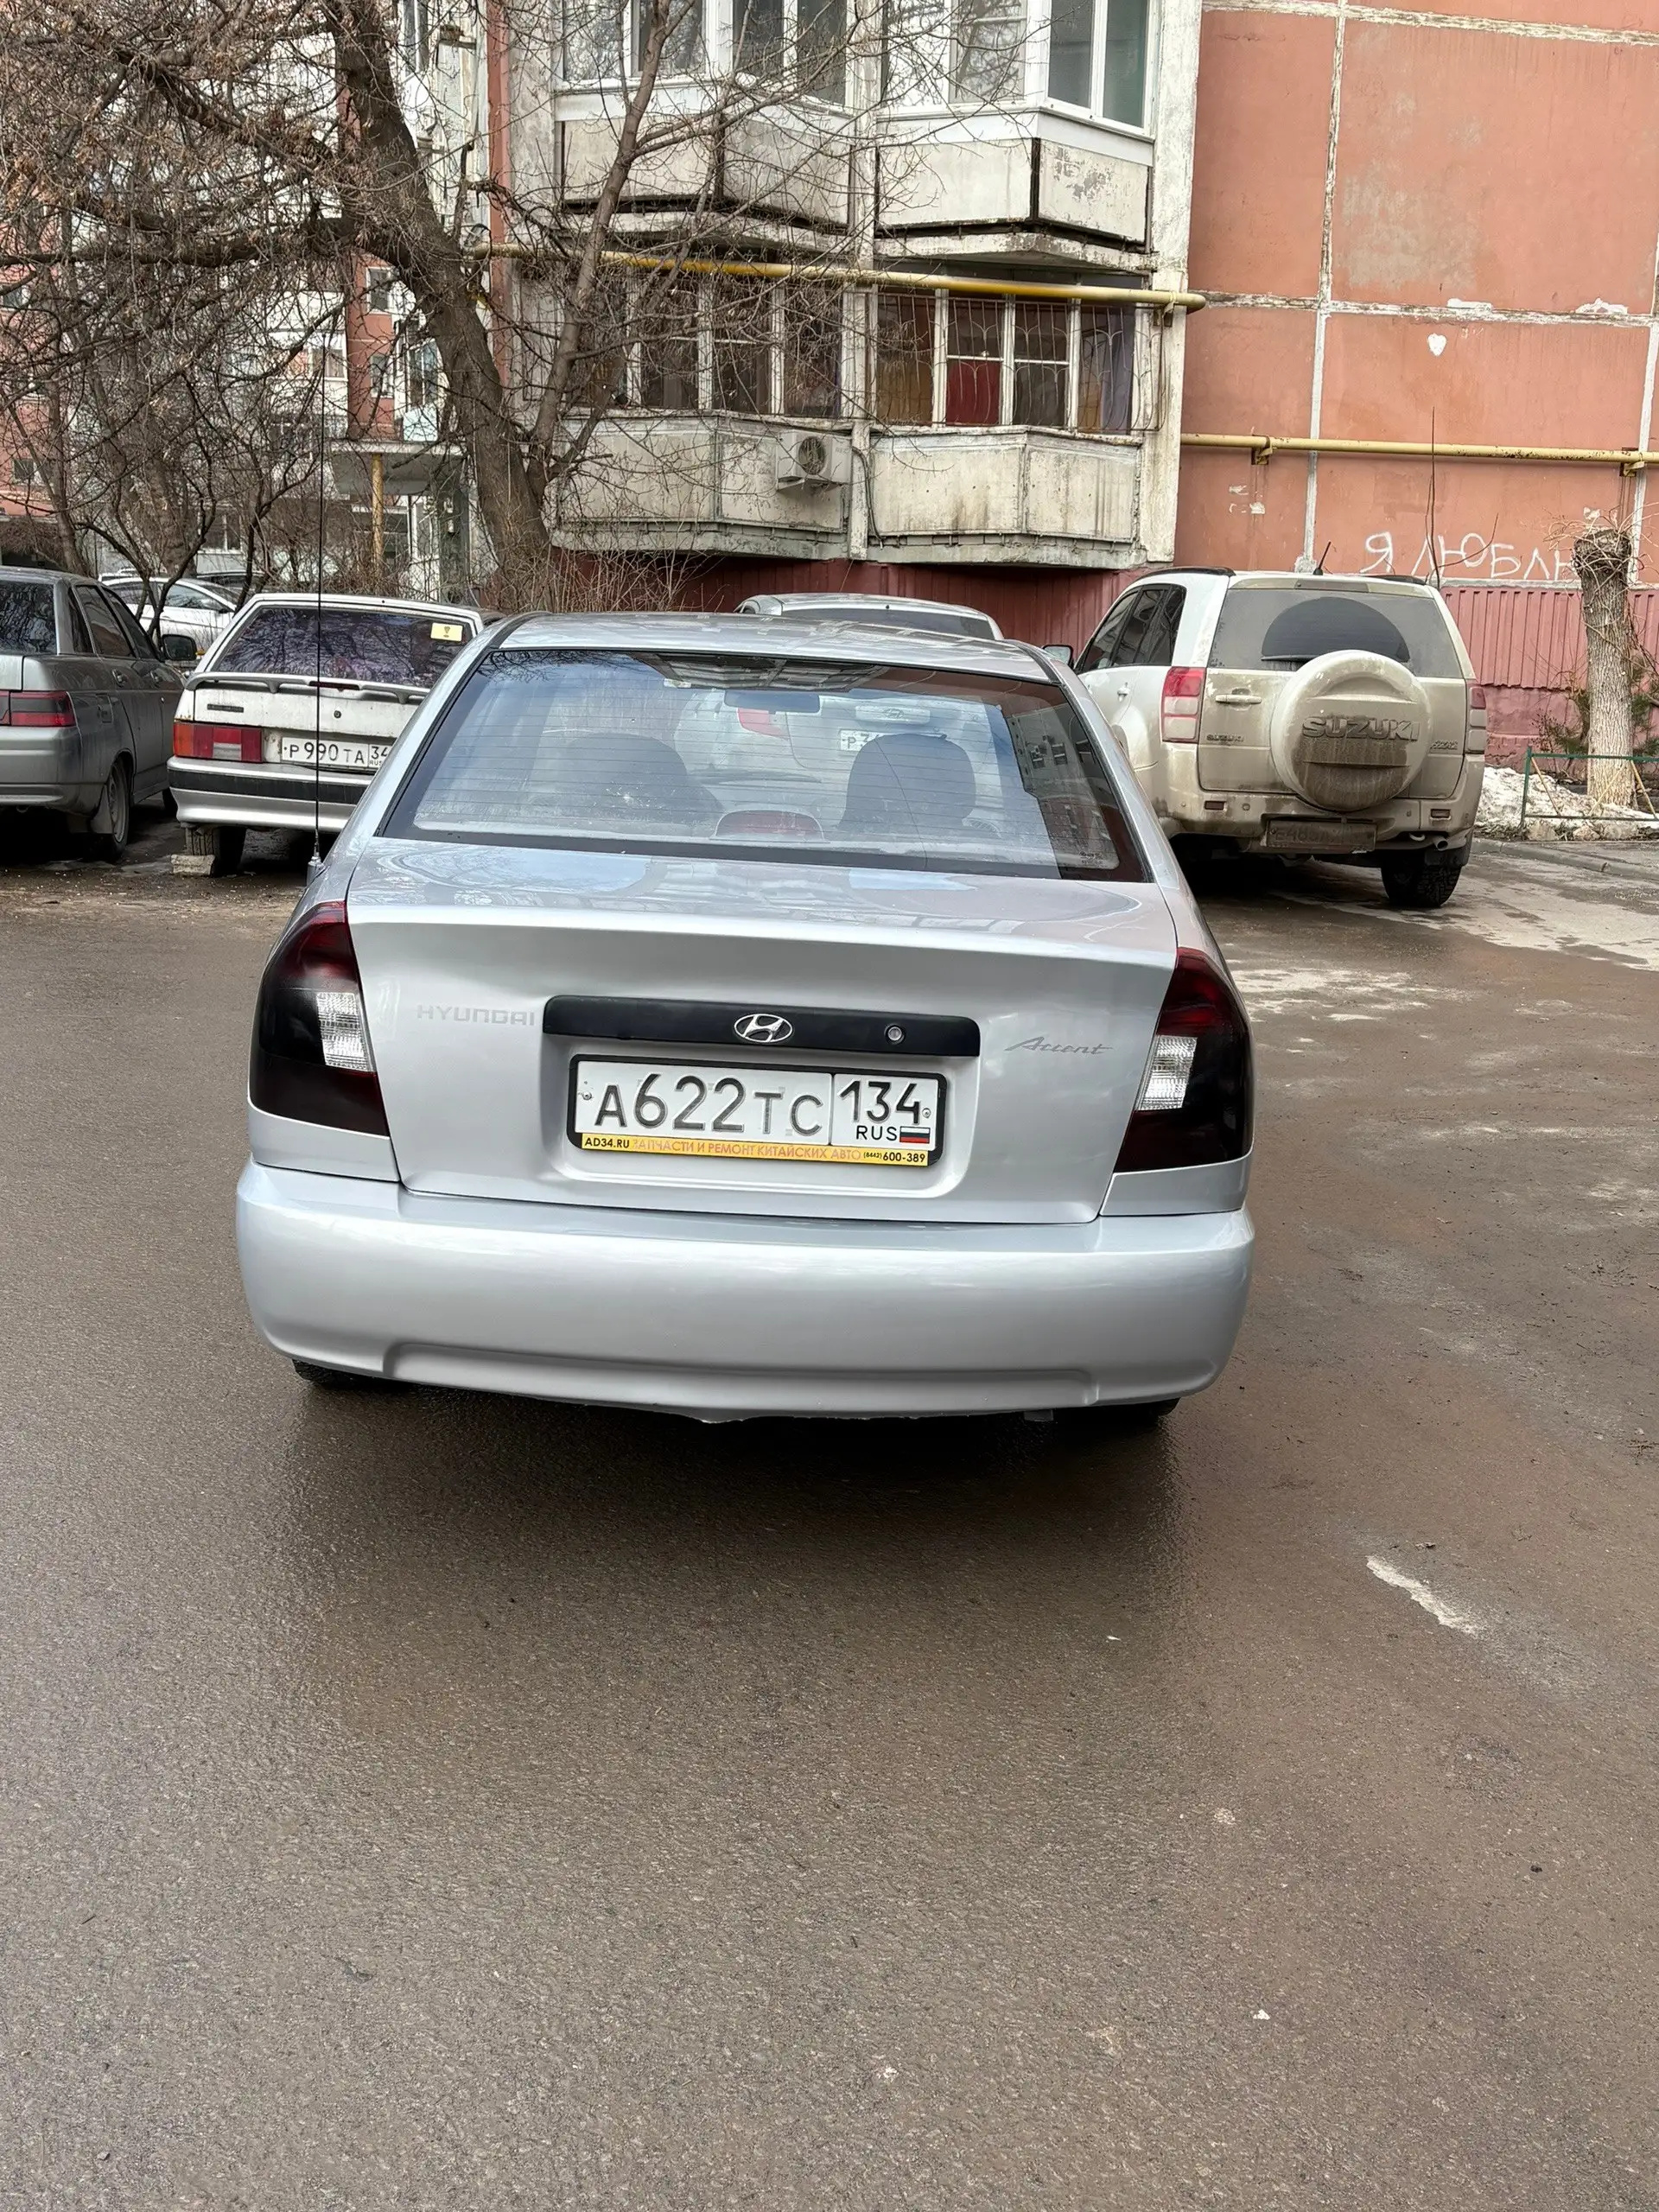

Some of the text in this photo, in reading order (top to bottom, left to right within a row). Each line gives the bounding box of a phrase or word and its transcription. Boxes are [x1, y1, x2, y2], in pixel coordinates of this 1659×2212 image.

[1359, 531, 1393, 574] Я
[1302, 715, 1421, 741] SUZUKI
[416, 1004, 535, 1026] HYUNDAI
[1003, 1036, 1113, 1055] Accent
[594, 1073, 822, 1135] А622ТС
[838, 1080, 921, 1126] 134
[856, 1125, 897, 1141] RUS
[584, 1137, 630, 1149] AD34.RU
[696, 1142, 706, 1154] И
[757, 1145, 827, 1159] КИТАЙСКИХ
[830, 1149, 861, 1160] АВТО
[883, 1151, 925, 1164] 600-389
